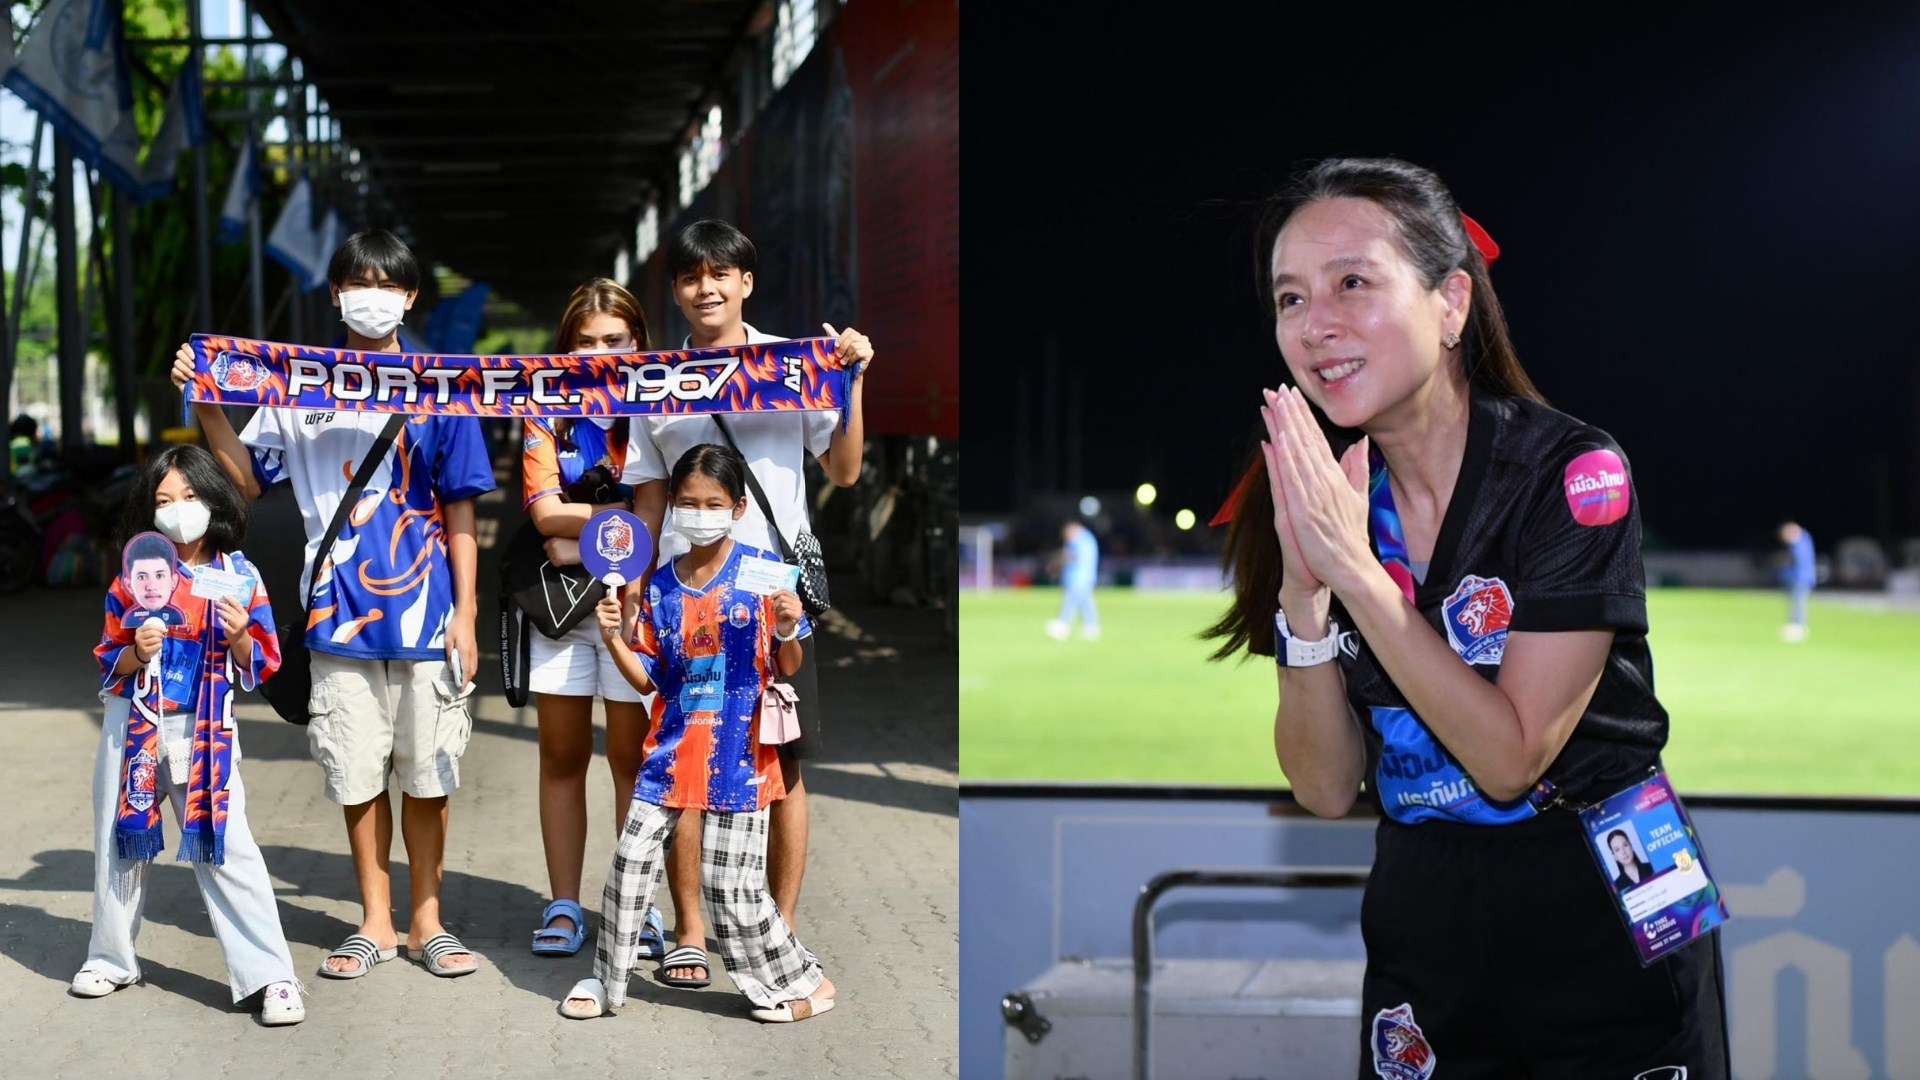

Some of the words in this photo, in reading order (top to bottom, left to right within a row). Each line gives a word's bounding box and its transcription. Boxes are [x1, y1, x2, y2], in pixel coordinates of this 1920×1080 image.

[288, 358, 463, 404] PORT
[482, 368, 582, 405] F.C.
[618, 357, 741, 402] 1967
[1569, 469, 1625, 496] เมืองไทย
[1646, 829, 1684, 852] OFFICIAL
[1649, 823, 1673, 839] TEAM
